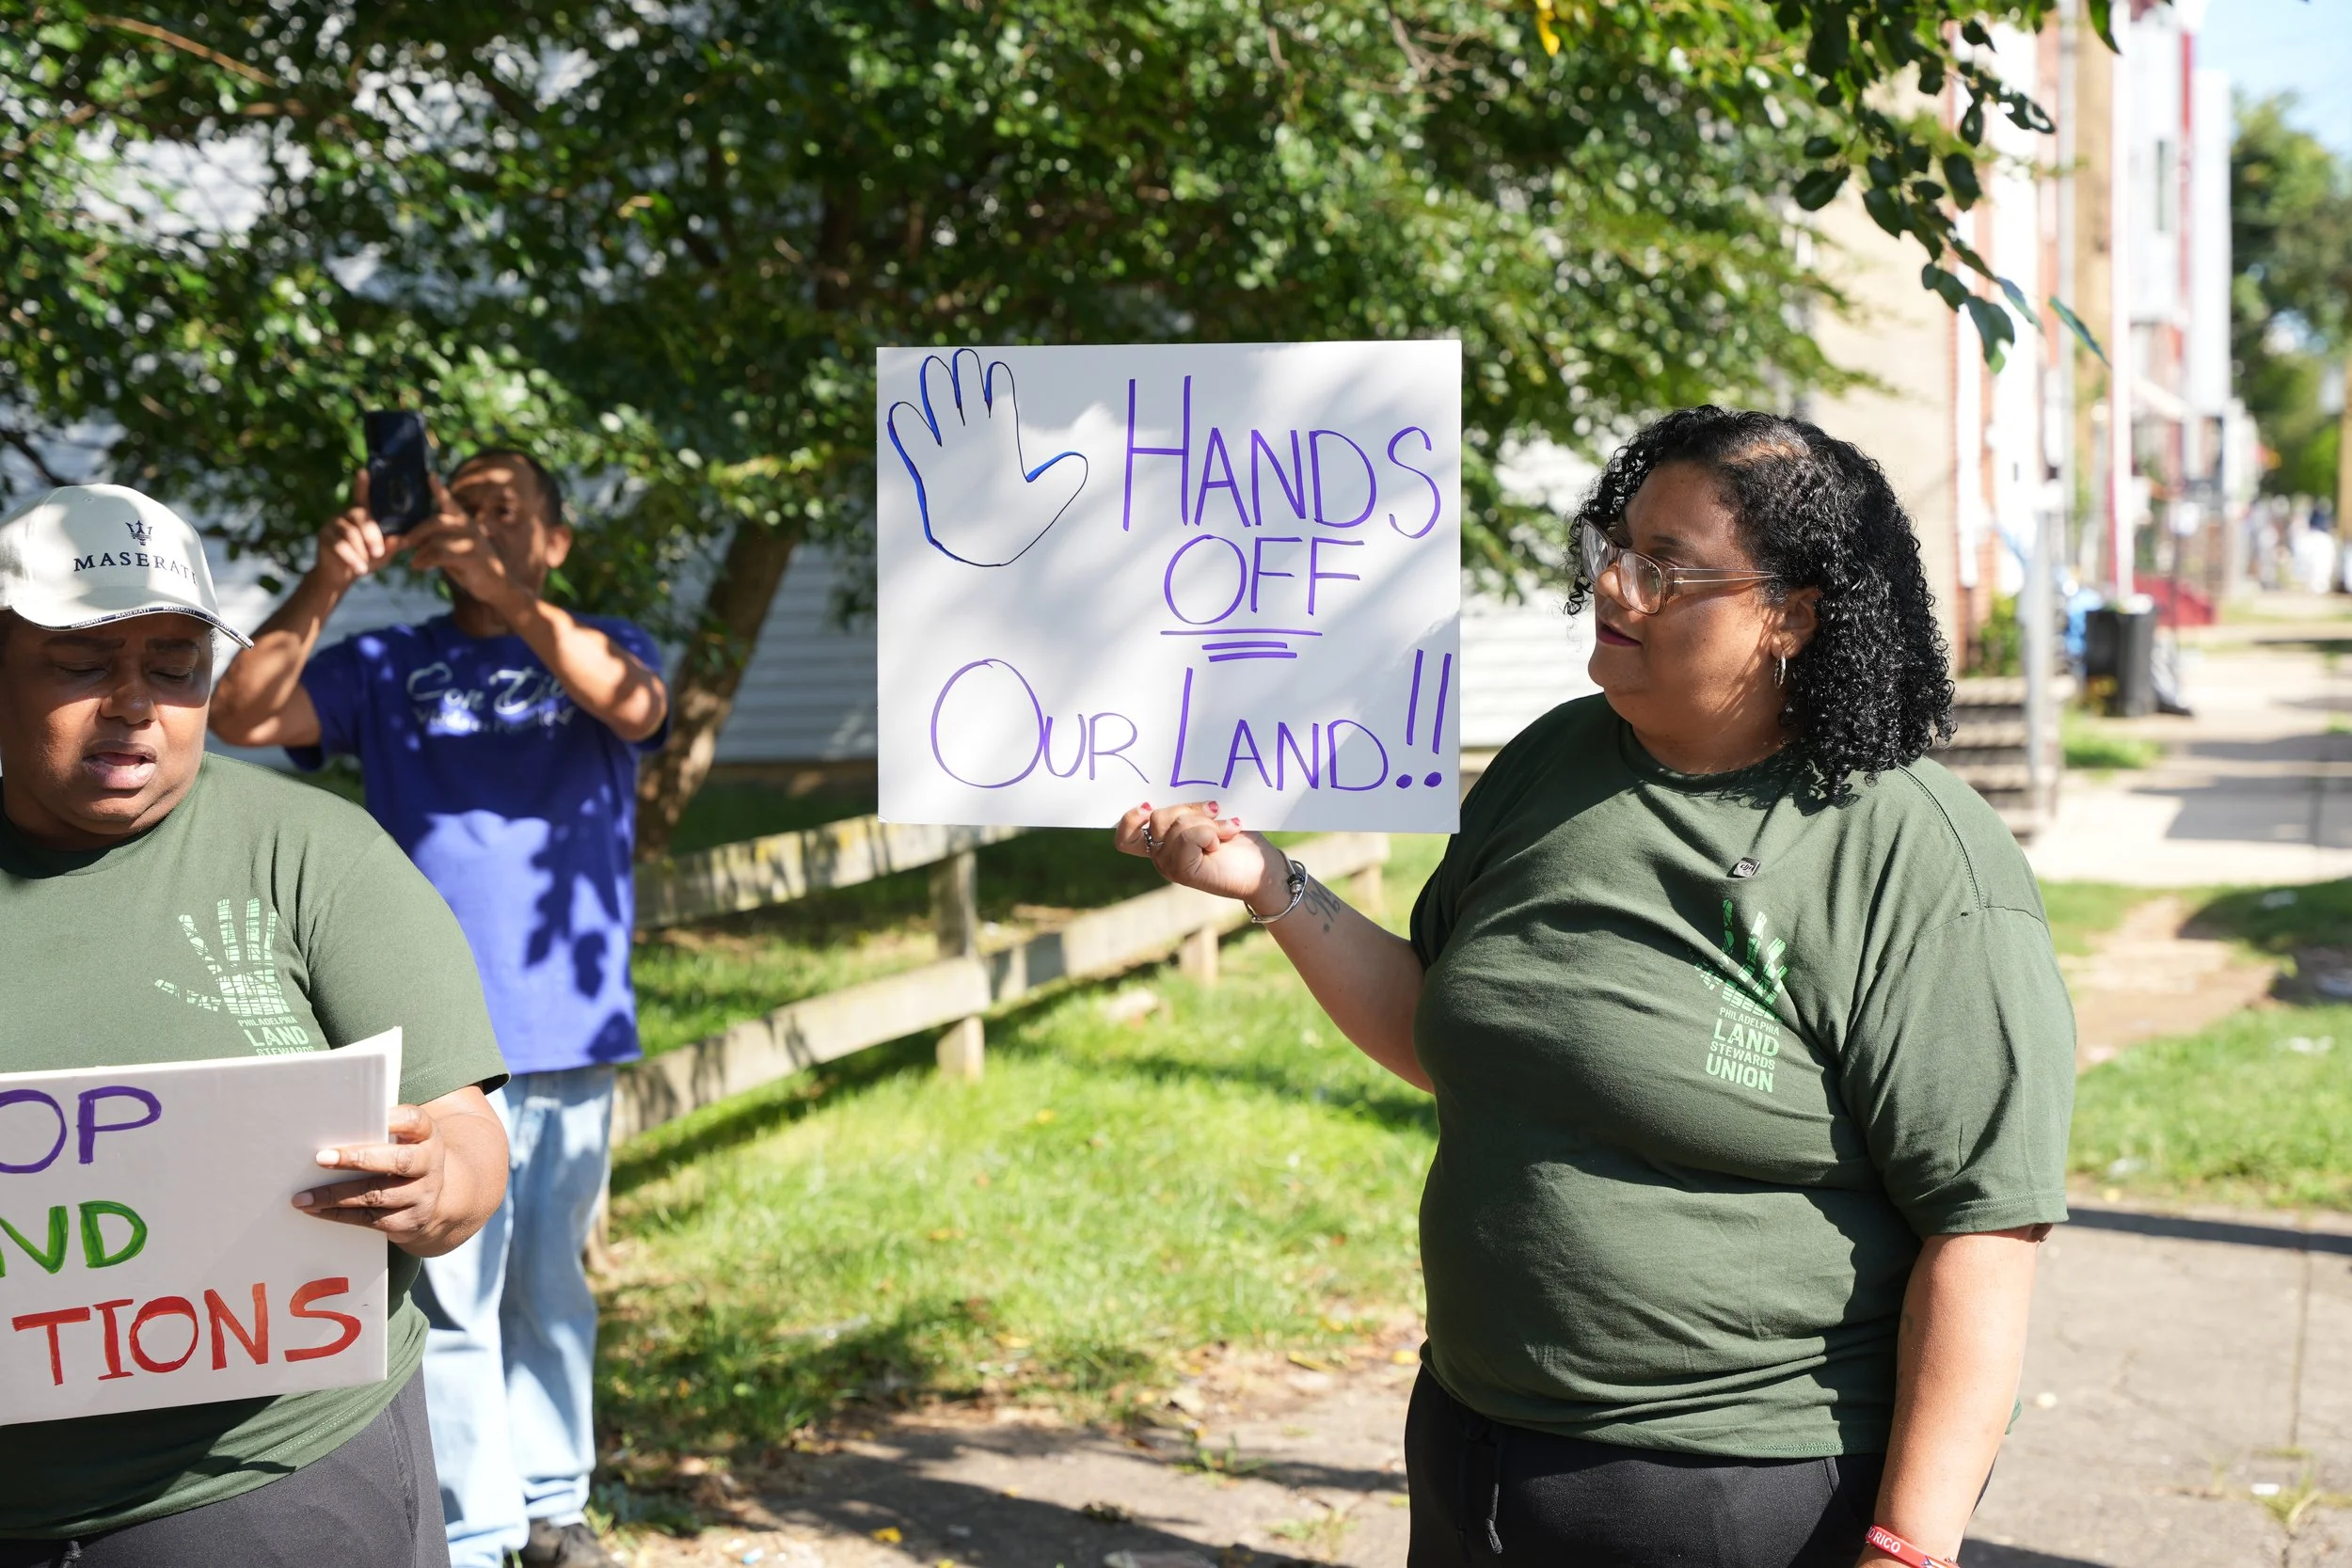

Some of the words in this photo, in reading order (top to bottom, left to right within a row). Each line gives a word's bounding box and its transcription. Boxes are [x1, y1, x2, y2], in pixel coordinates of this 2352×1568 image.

[1122, 374, 1441, 539] HANDS
[73, 551, 198, 586] MASERATI
[1164, 533, 1365, 625] OFF
[930, 657, 1151, 789] OUR
[237, 1015, 298, 1027] PHILADELPHIA
[243, 1025, 310, 1047] LAND
[1712, 1018, 1780, 1058] LAND
[1719, 1006, 1781, 1037] PHILADELPHIA
[1709, 1039, 1776, 1071] STEWARDS
[1705, 1053, 1774, 1093] UNION
[1872, 1531, 1901, 1554] RICO
